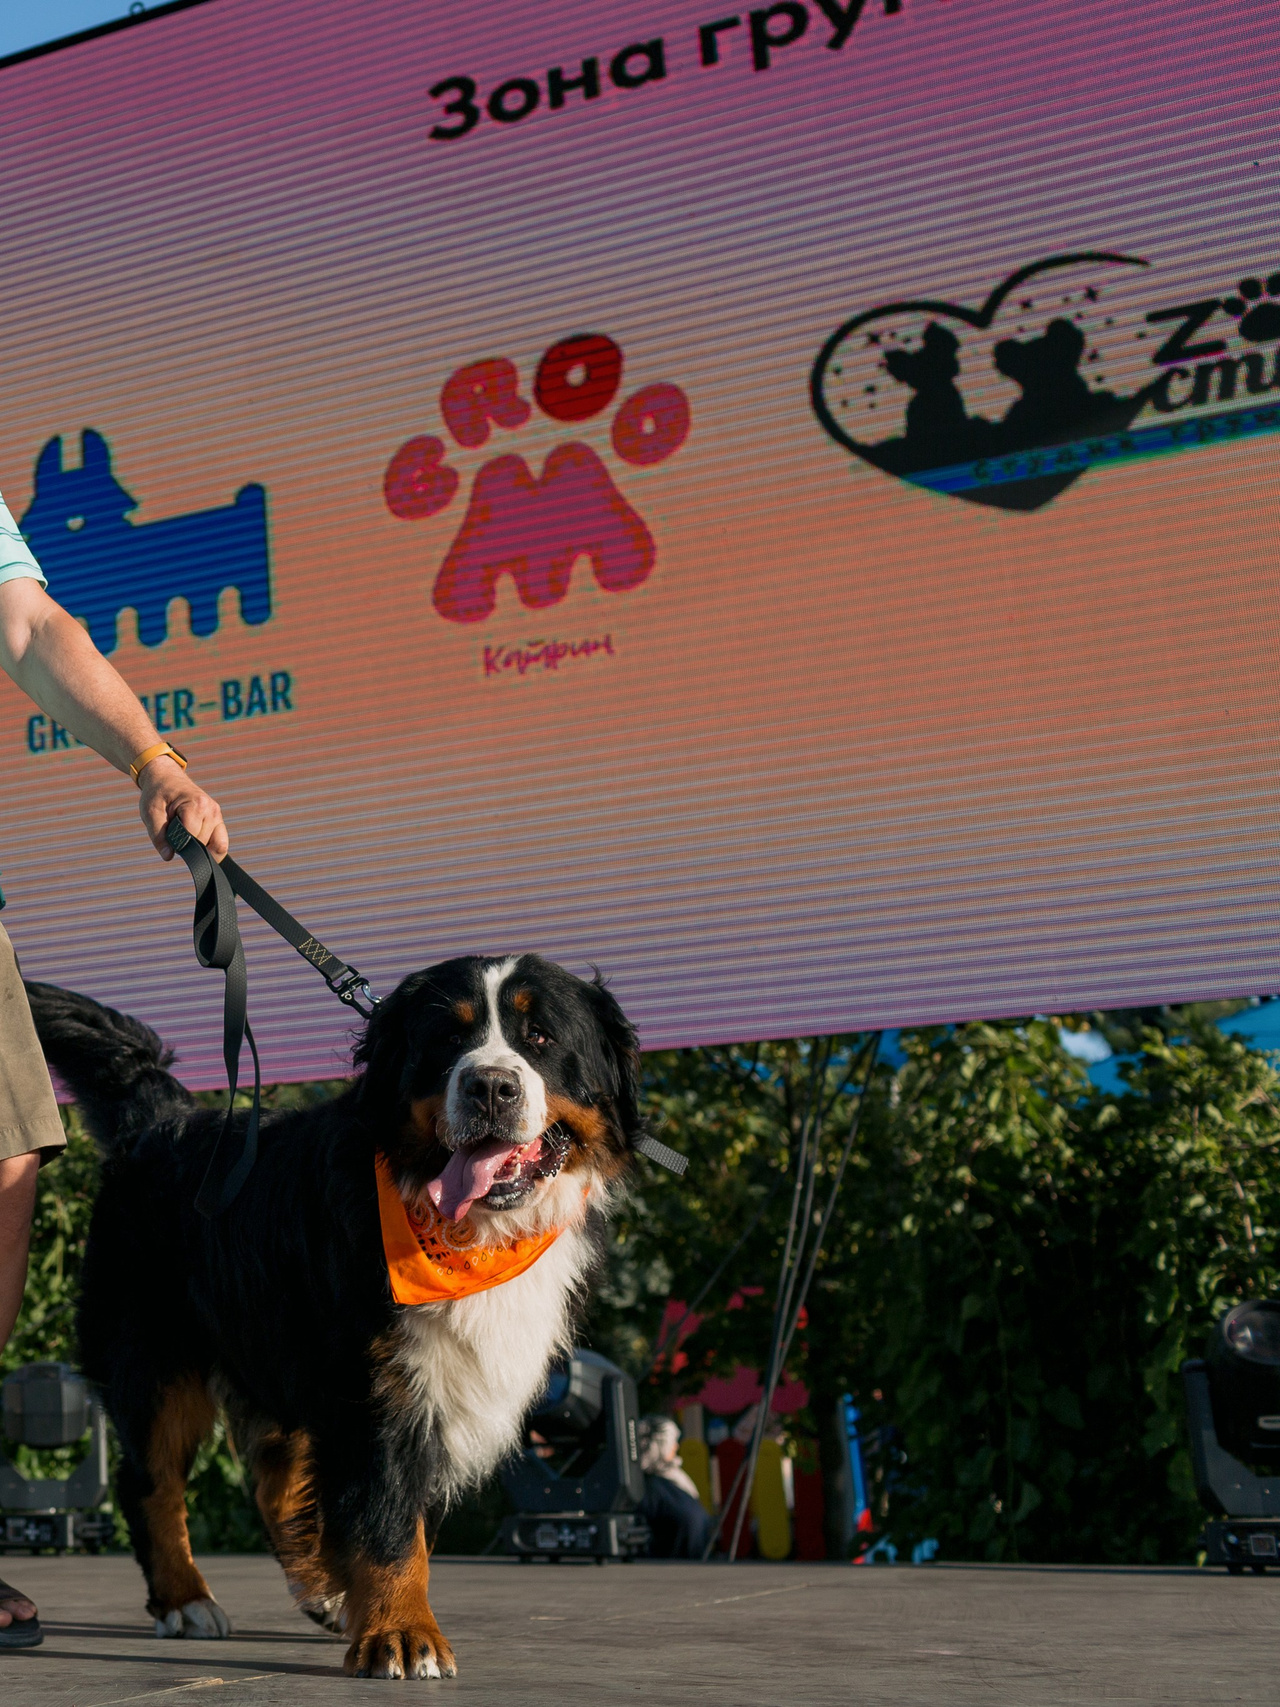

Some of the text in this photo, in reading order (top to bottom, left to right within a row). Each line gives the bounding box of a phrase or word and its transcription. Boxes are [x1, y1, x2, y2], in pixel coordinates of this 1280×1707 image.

[427, 0, 902, 141] Зона гру
[27, 670, 294, 754] GRER-BAR
